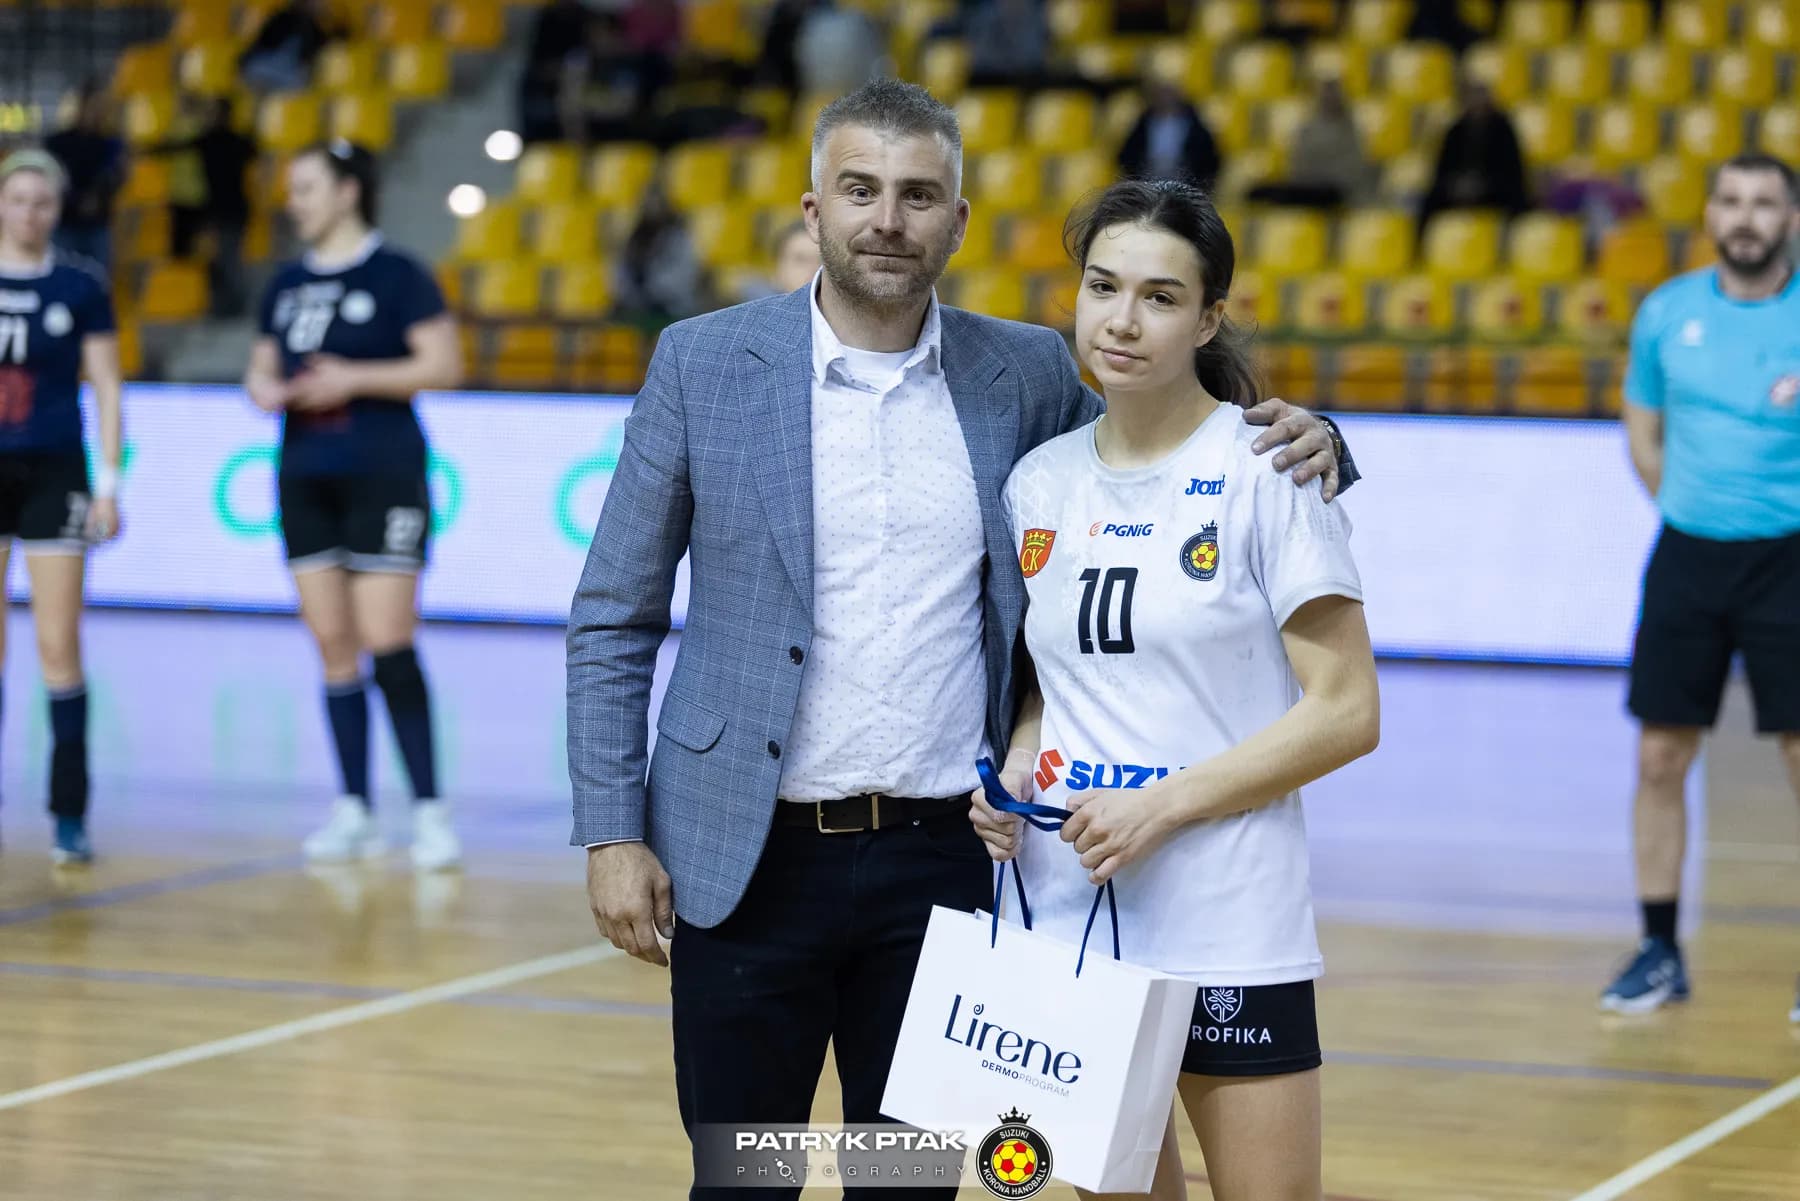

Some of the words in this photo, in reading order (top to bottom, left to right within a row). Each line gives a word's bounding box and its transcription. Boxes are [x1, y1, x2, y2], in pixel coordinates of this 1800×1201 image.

[1021, 548, 1043, 572] CK
[1078, 568, 1138, 654] 10
[1065, 759, 1187, 791] SUZ
[944, 993, 1082, 1084] Lirene
[1191, 1024, 1273, 1044] ROFIKA
[981, 1059, 1070, 1098] DERMOPROGRAM
